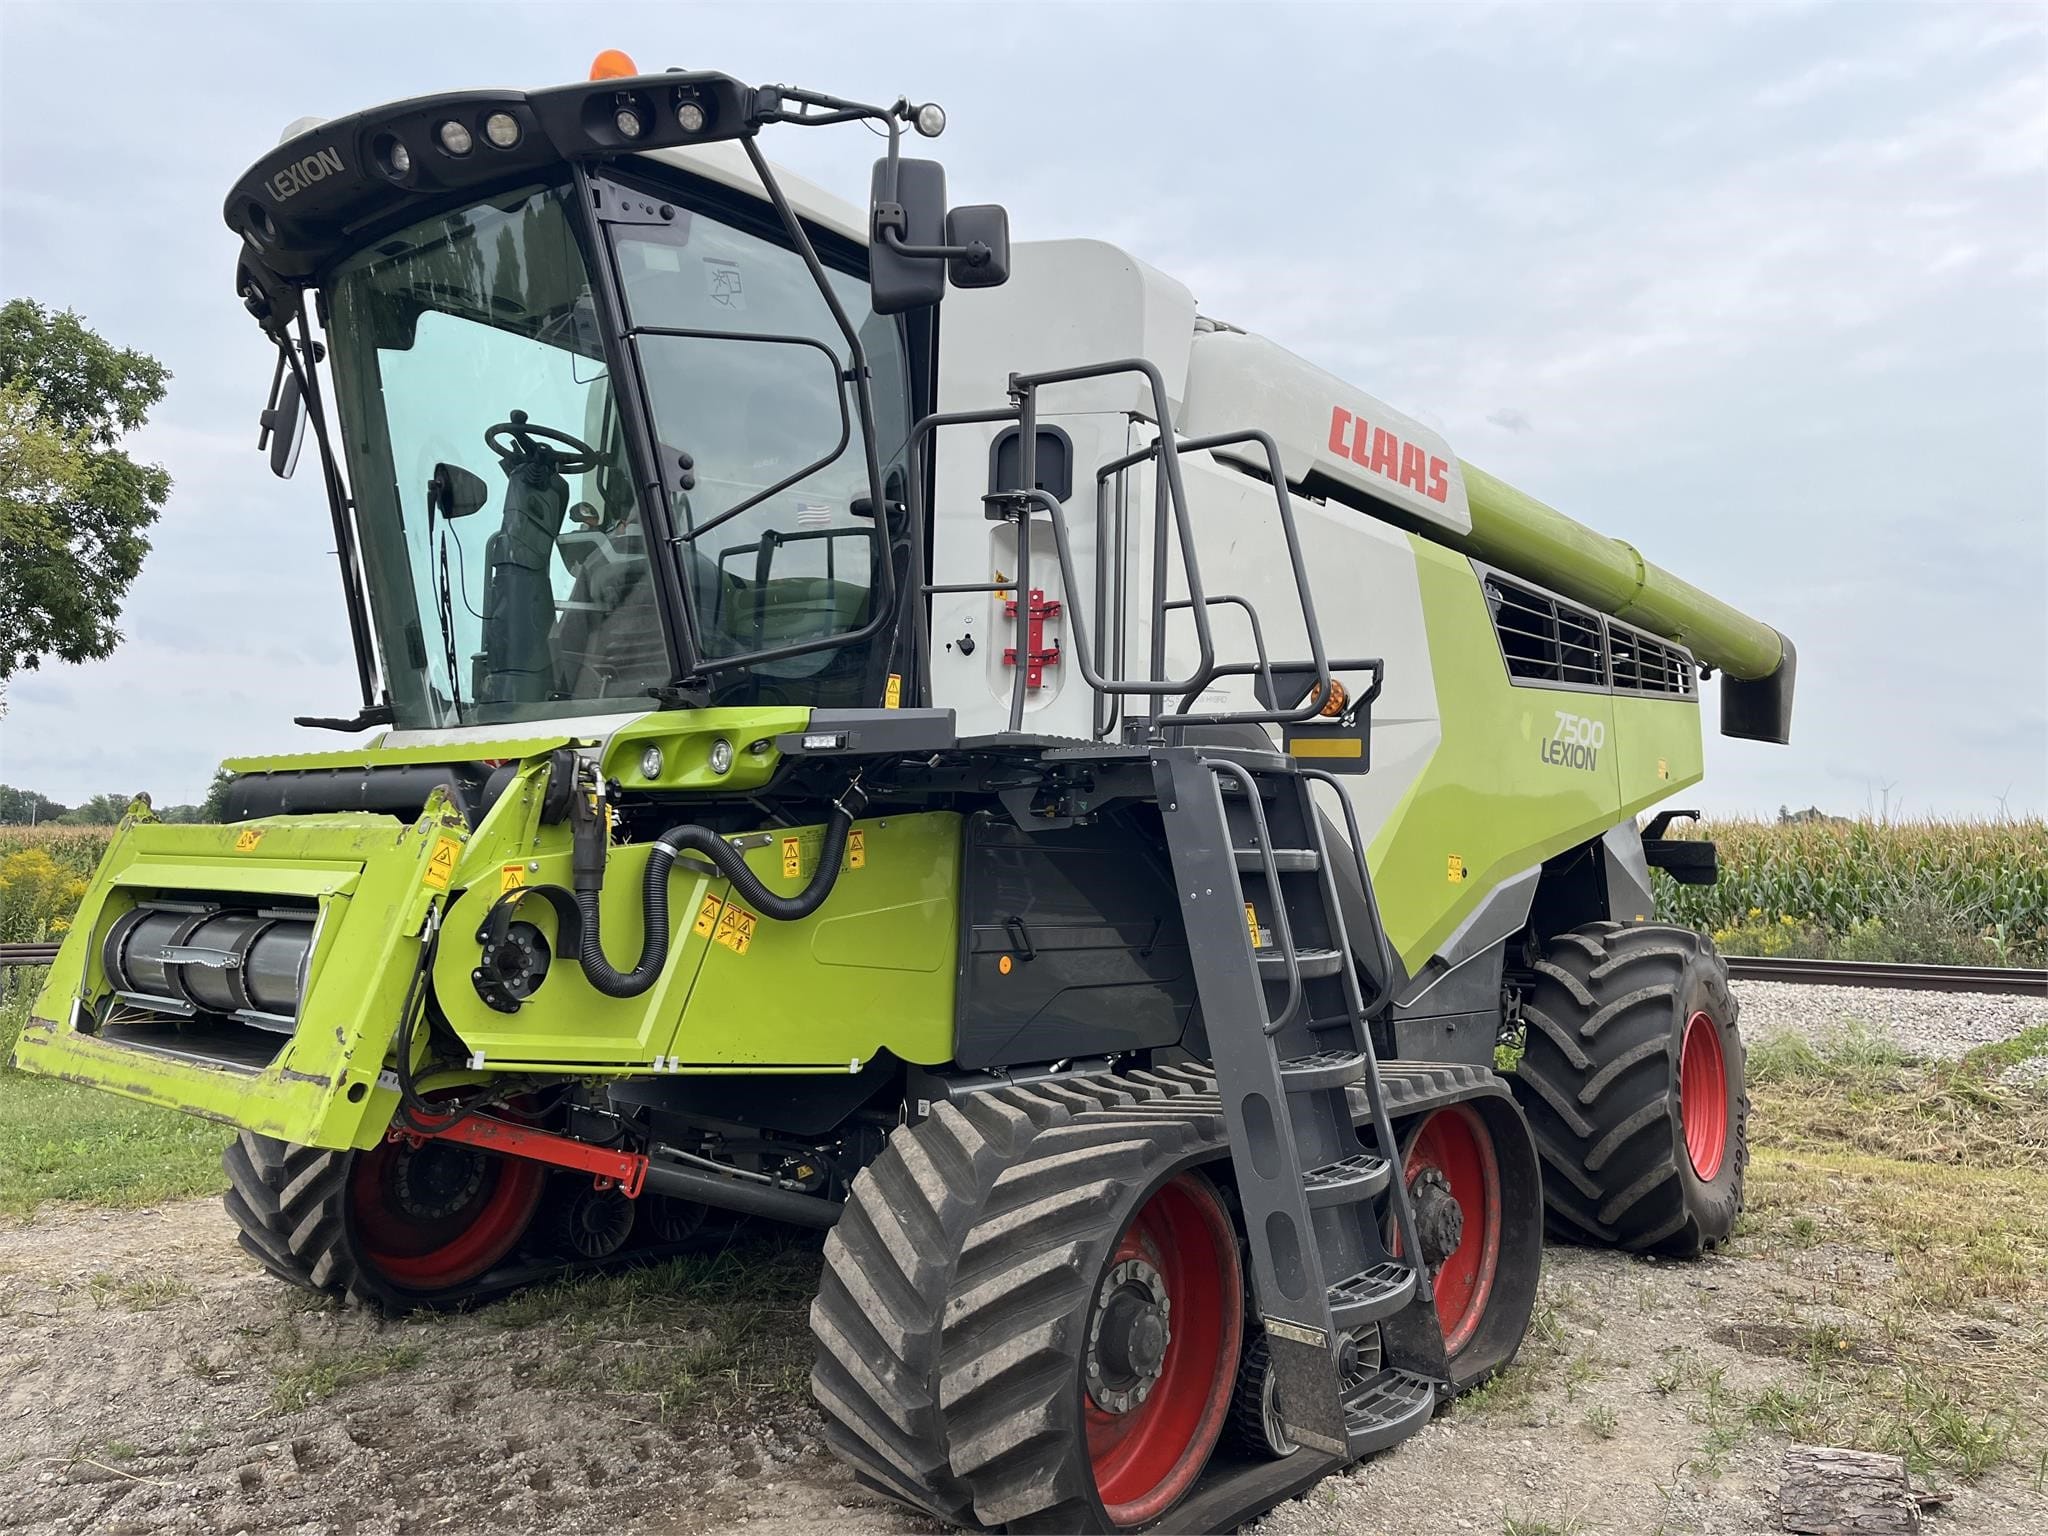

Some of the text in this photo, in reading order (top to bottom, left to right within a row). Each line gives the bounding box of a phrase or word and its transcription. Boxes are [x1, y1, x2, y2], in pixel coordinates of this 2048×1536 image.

[264, 146, 345, 202] LEXION
[1328, 406, 1448, 504] CLAAS
[1554, 710, 1605, 749] 7500
[1541, 737, 1597, 771] LEXION
